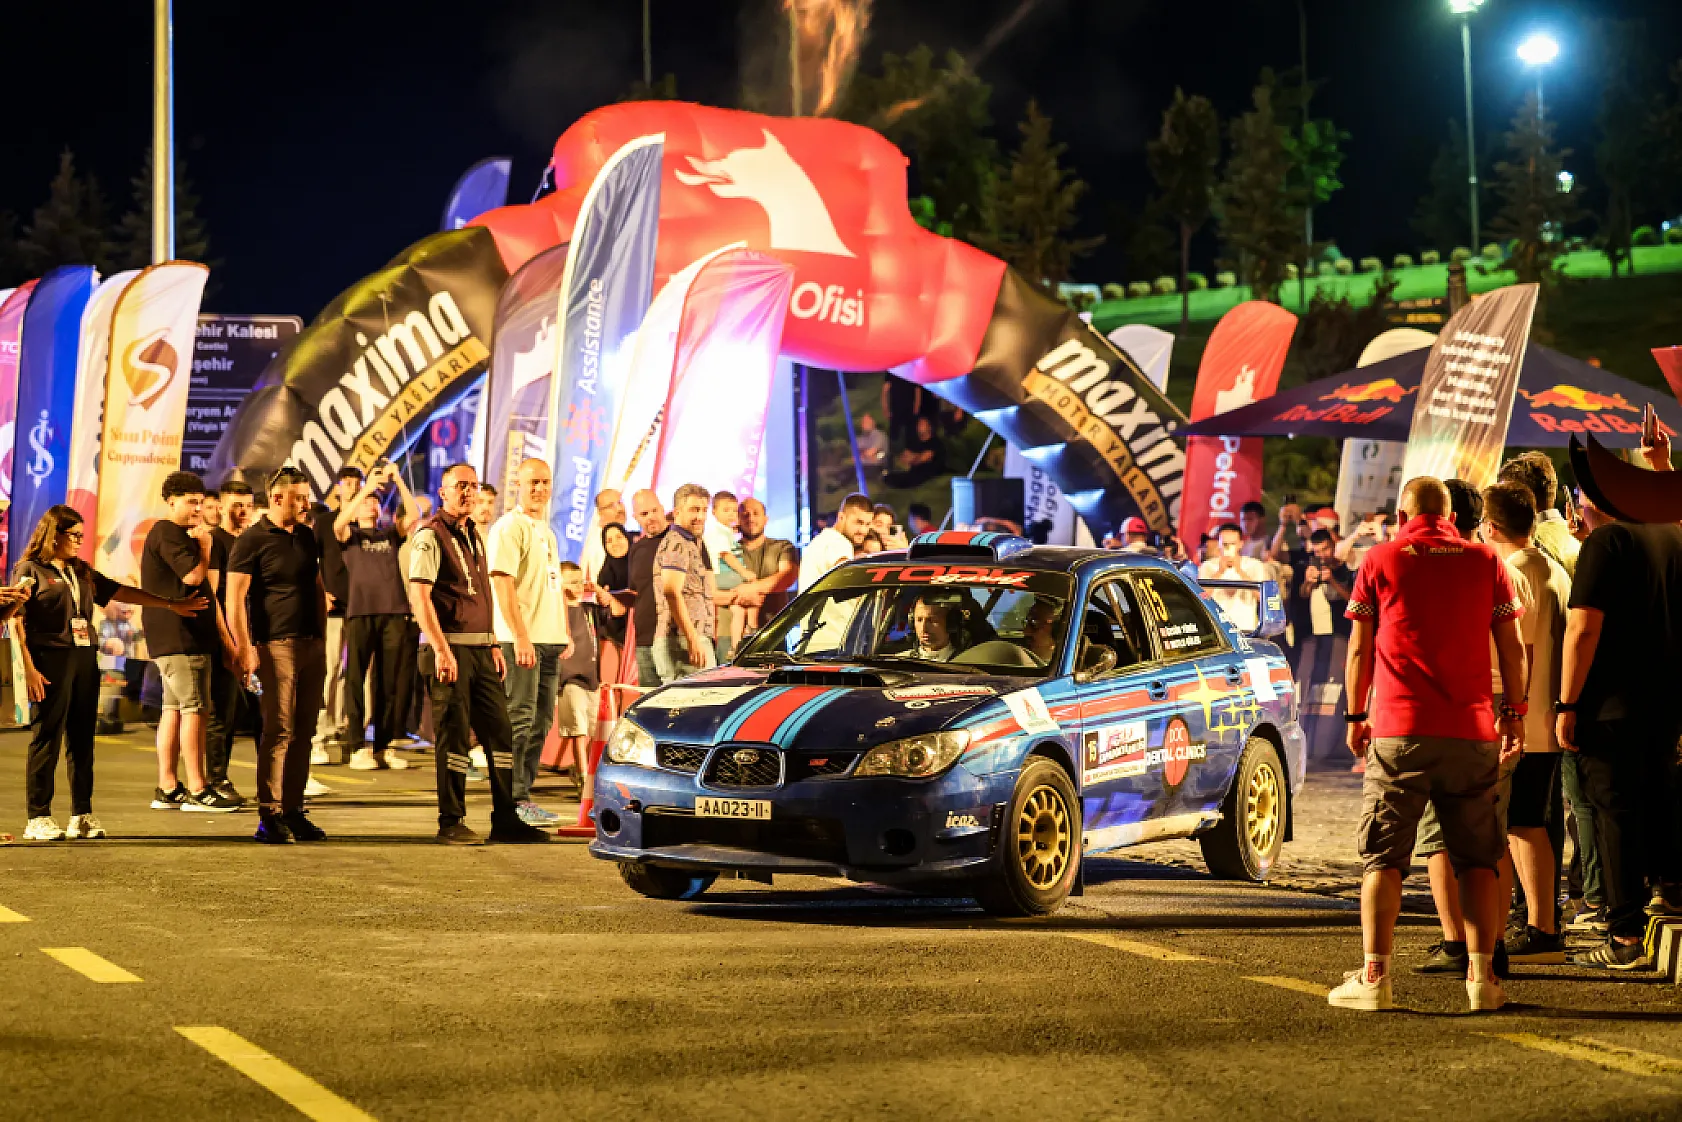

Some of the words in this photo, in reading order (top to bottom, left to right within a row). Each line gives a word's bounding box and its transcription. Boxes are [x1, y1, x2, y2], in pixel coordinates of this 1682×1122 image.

[577, 278, 603, 395] Assistance
[791, 281, 865, 327] Ofisi
[283, 290, 471, 501] maxima
[1529, 412, 1612, 433] Red
[566, 456, 593, 542] Remed
[1209, 435, 1241, 518] Petrol
[1138, 578, 1169, 622] 15
